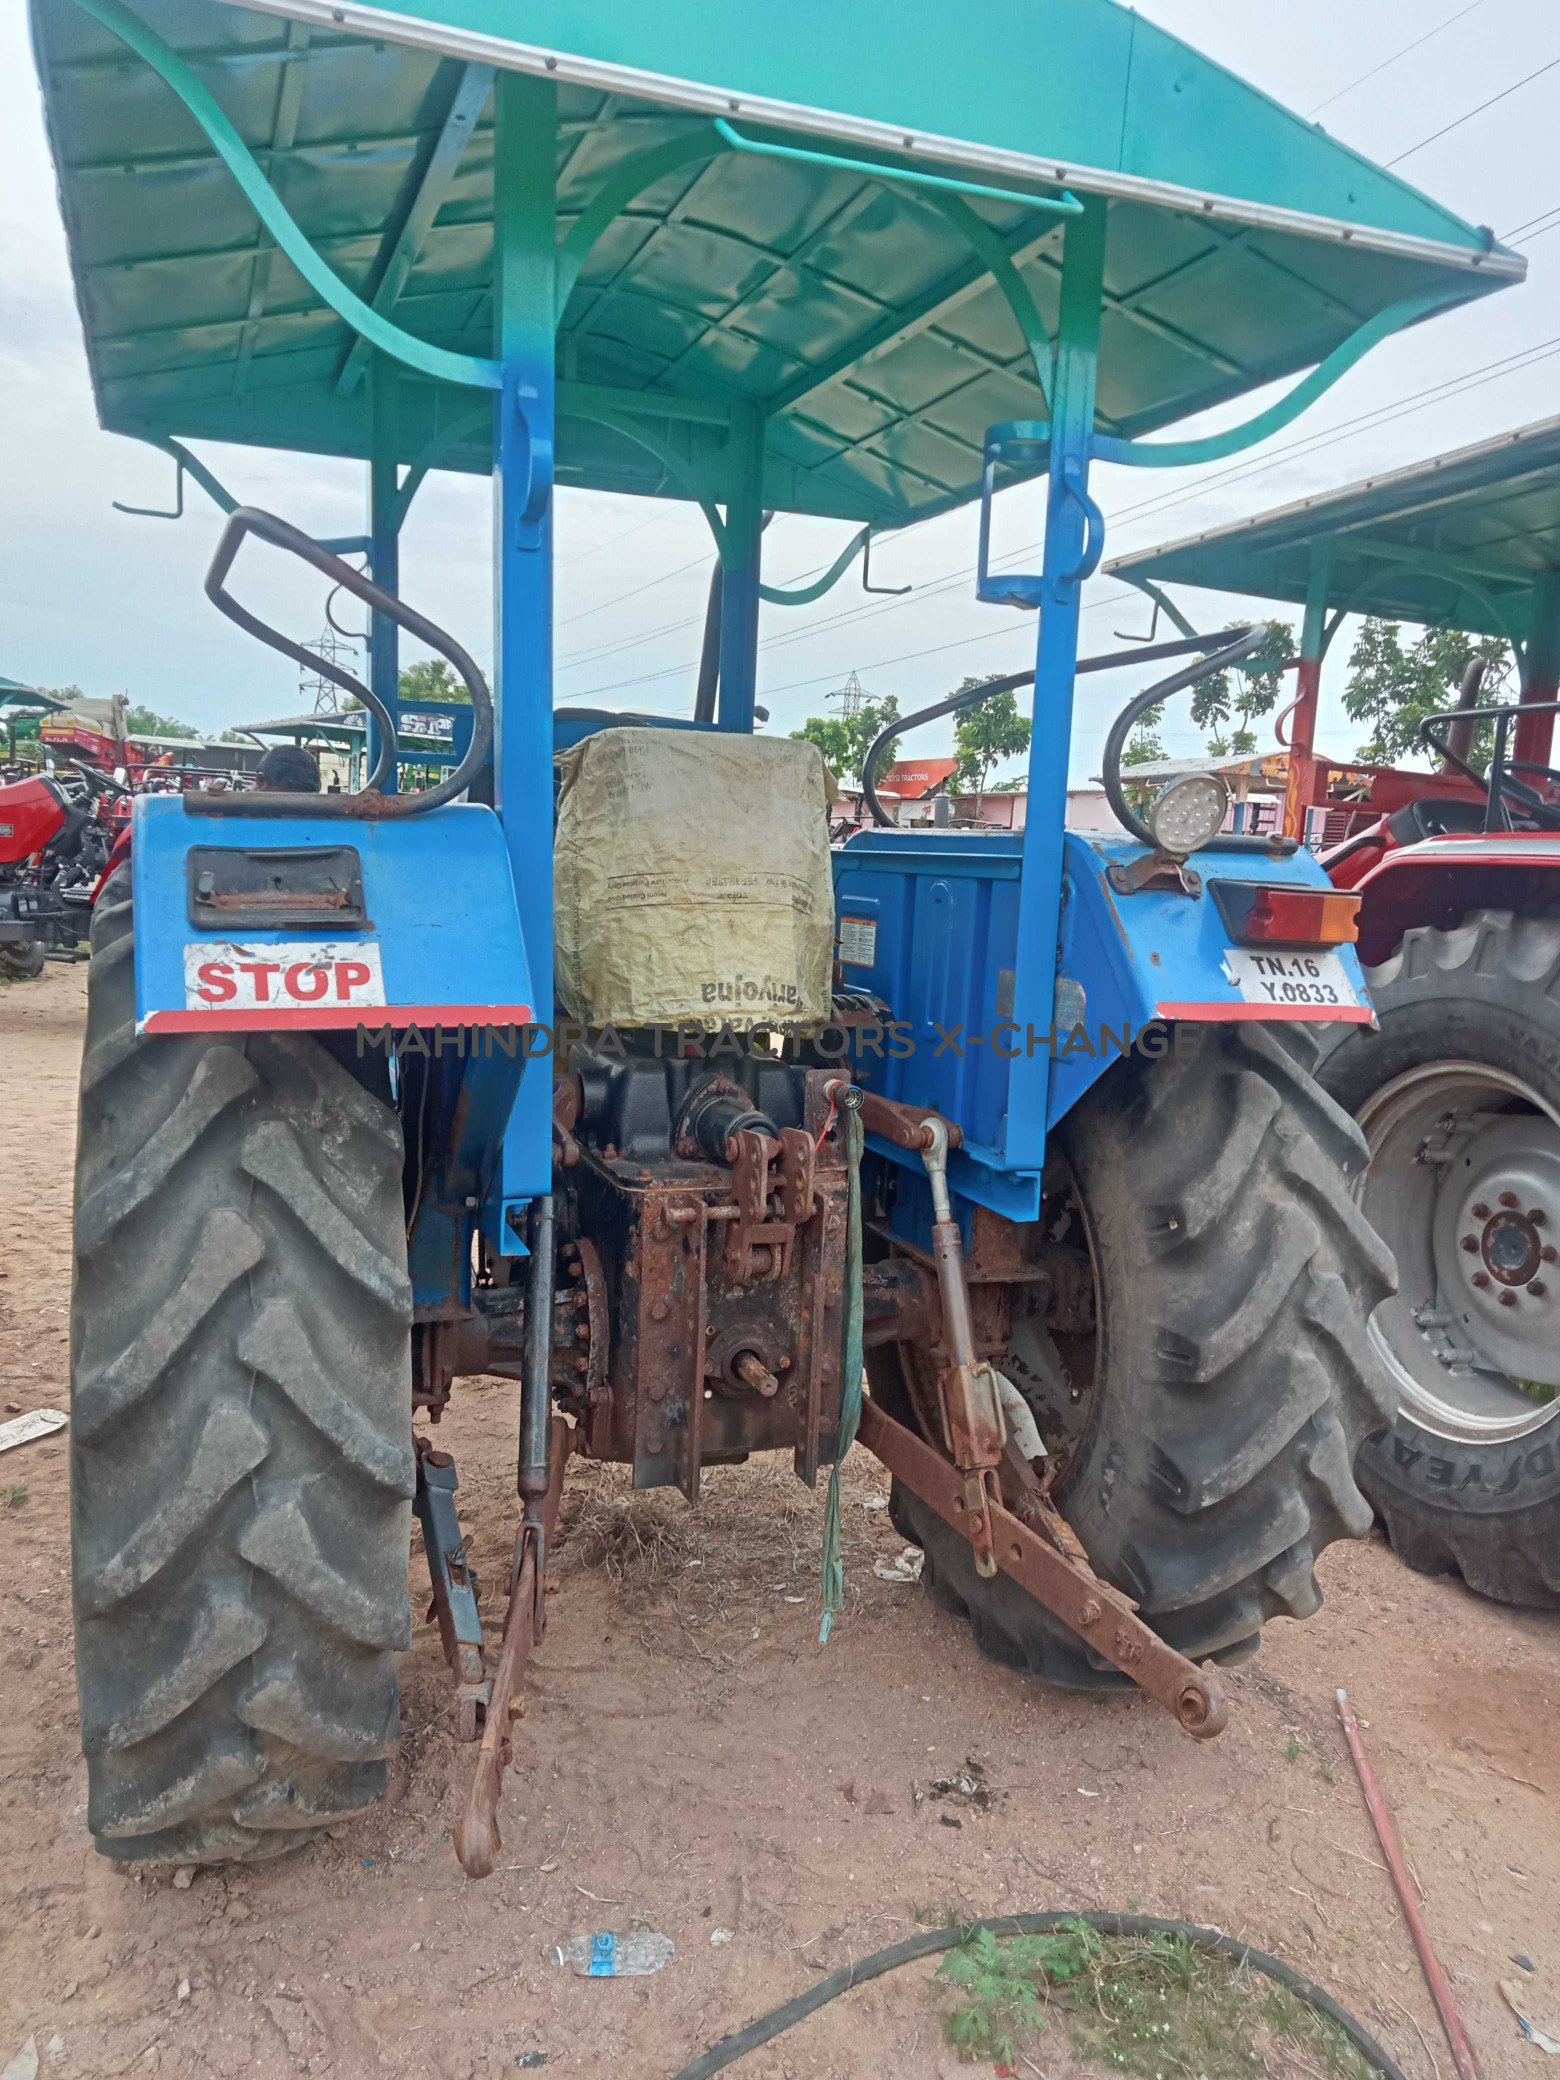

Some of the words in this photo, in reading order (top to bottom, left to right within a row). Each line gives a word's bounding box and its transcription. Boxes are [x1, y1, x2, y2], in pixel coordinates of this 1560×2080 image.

[901, 773, 929, 781] TRACTORS
[1250, 955, 1320, 978] TN.16
[197, 962, 371, 1003] STOP
[1260, 981, 1339, 1004] Y.0833
